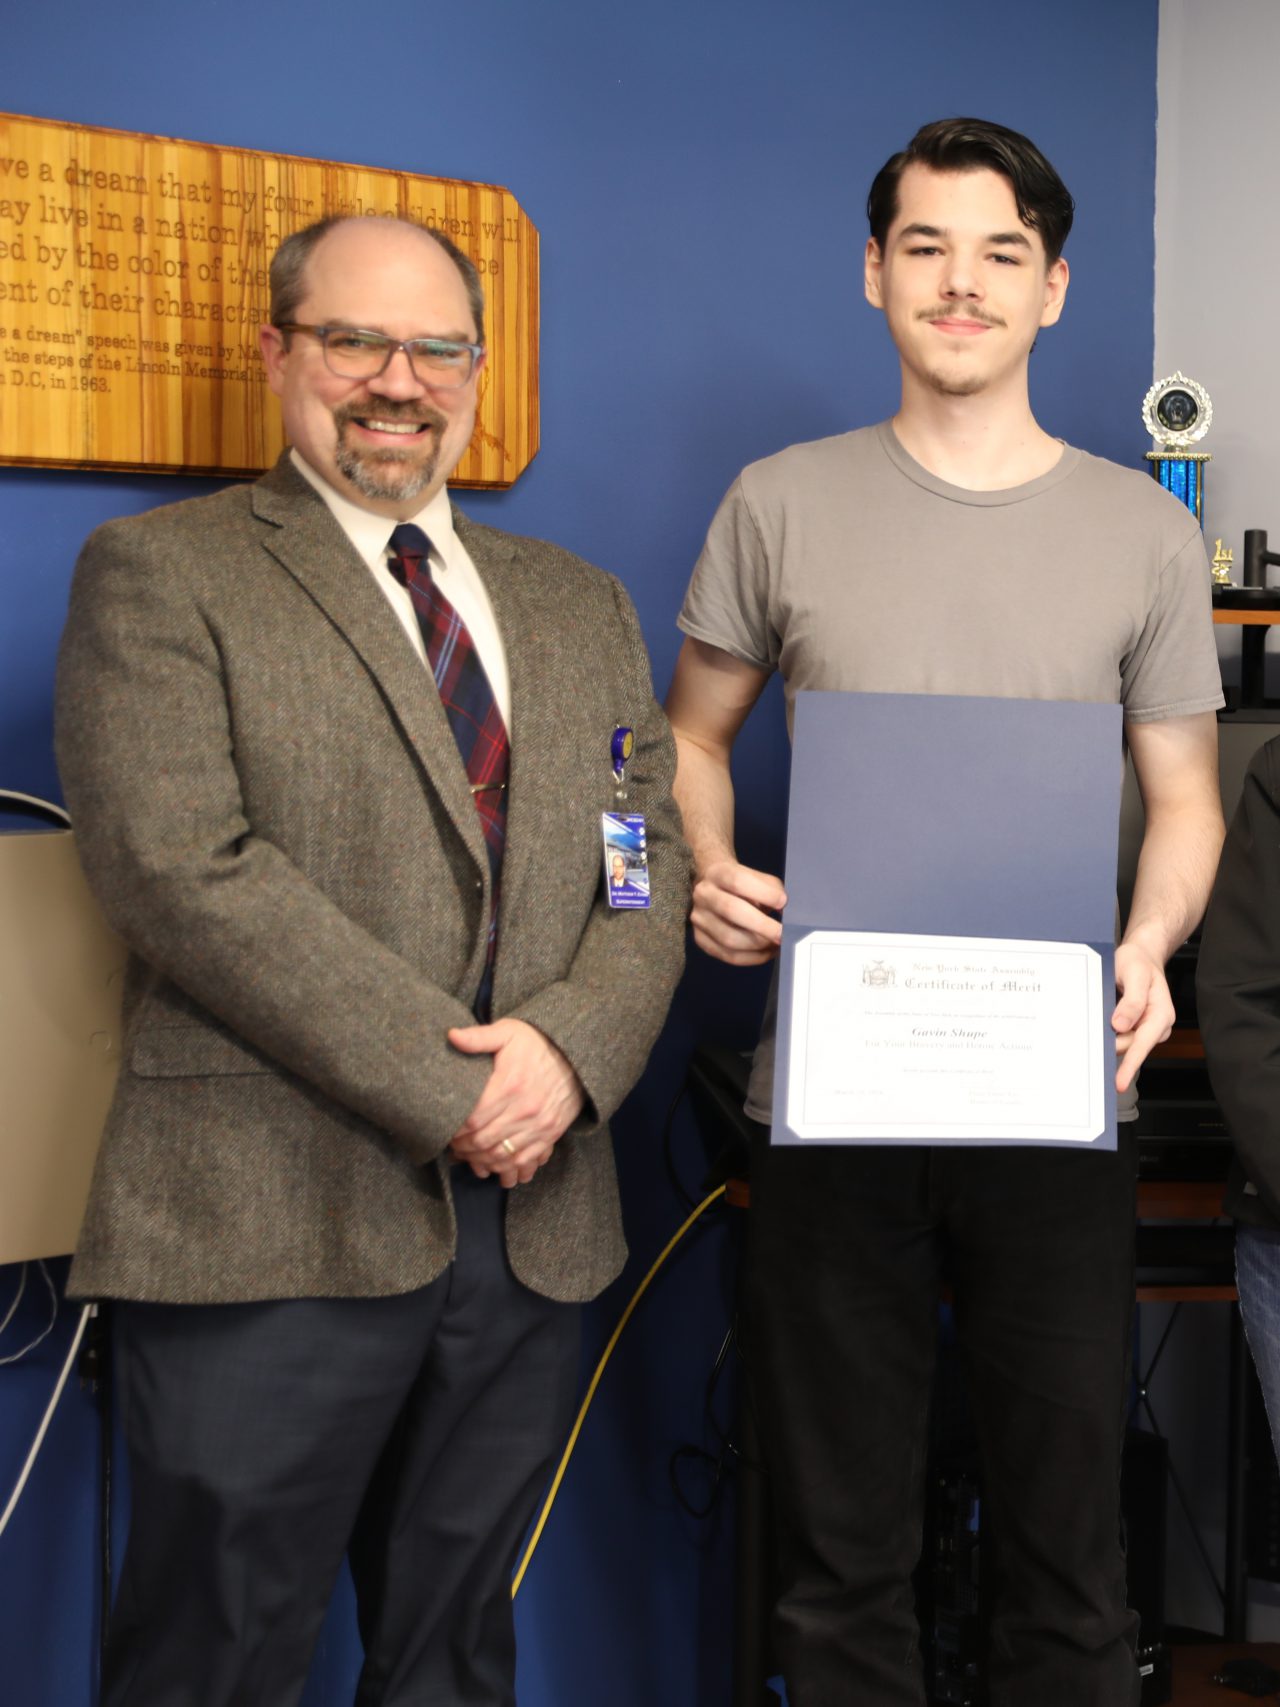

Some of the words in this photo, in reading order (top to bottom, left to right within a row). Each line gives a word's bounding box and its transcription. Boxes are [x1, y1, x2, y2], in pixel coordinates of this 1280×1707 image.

[38, 162, 55, 183] a
[65, 158, 149, 195] dream
[157, 173, 212, 204] that
[220, 187, 257, 214] my
[264, 186, 315, 217] four
[482, 218, 521, 242] will
[39, 195, 89, 228] live
[97, 203, 124, 232] in
[133, 215, 148, 235] a
[156, 216, 238, 246] nation
[246, 225, 281, 250] wh
[33, 235, 68, 271] by
[76, 242, 120, 272] the
[128, 249, 190, 279] color
[198, 256, 222, 283] of
[227, 259, 271, 288] the
[47, 280, 74, 307] of
[79, 283, 145, 314] their
[155, 291, 270, 324] character
[12, 328, 22, 340] a
[87, 334, 137, 351] speech
[140, 339, 170, 353] was
[175, 338, 213, 357] given
[217, 341, 234, 361] by
[238, 344, 265, 361] Ma
[4, 346, 30, 363] the
[34, 351, 75, 369] steps
[79, 353, 94, 369] of
[97, 354, 122, 371] the
[125, 356, 180, 376] Lincoln
[184, 361, 253, 381] Memorial
[50, 373, 66, 389] in
[71, 376, 112, 393] 1963.
[904, 977, 976, 992] Certificate
[981, 979, 995, 992] of
[1000, 980, 1042, 993] Merit
[911, 1027, 947, 1038] Gavin
[950, 1027, 989, 1040] Shupe
